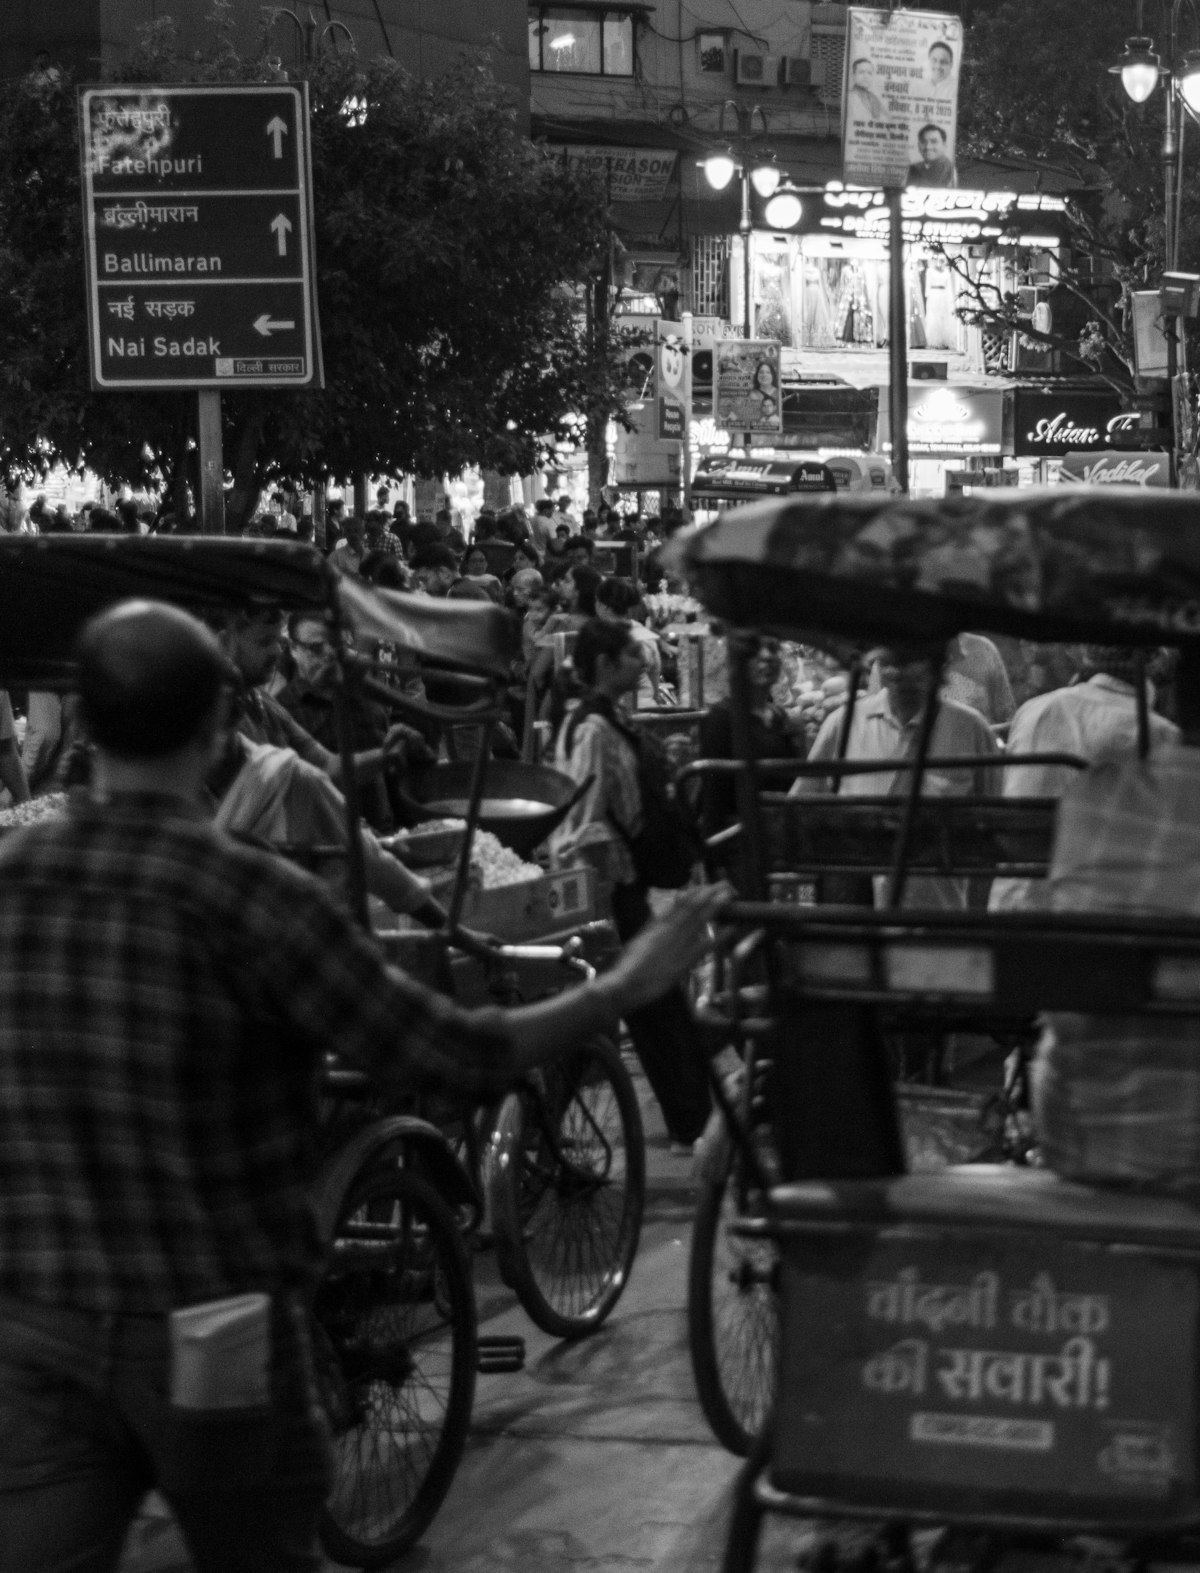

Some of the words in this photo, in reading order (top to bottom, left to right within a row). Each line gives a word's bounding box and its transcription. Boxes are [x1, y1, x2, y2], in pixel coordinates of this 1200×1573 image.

[99, 154, 202, 177] Fatehpuri
[842, 215, 922, 232] DESIGER
[923, 221, 981, 238] STUDIO
[104, 253, 222, 273] Ballimaran
[107, 296, 136, 321] नई
[144, 300, 195, 321] सड़क
[108, 337, 145, 357] Nai
[154, 336, 222, 357] Sadak
[236, 359, 264, 374] दिल्ली
[269, 361, 301, 373] सरकार
[800, 469, 825, 483] Amul
[1083, 457, 1160, 488] Vadilal
[1007, 1269, 1110, 1335] चौक
[862, 1337, 929, 1396] की
[937, 1335, 1112, 1410] सवारी!
